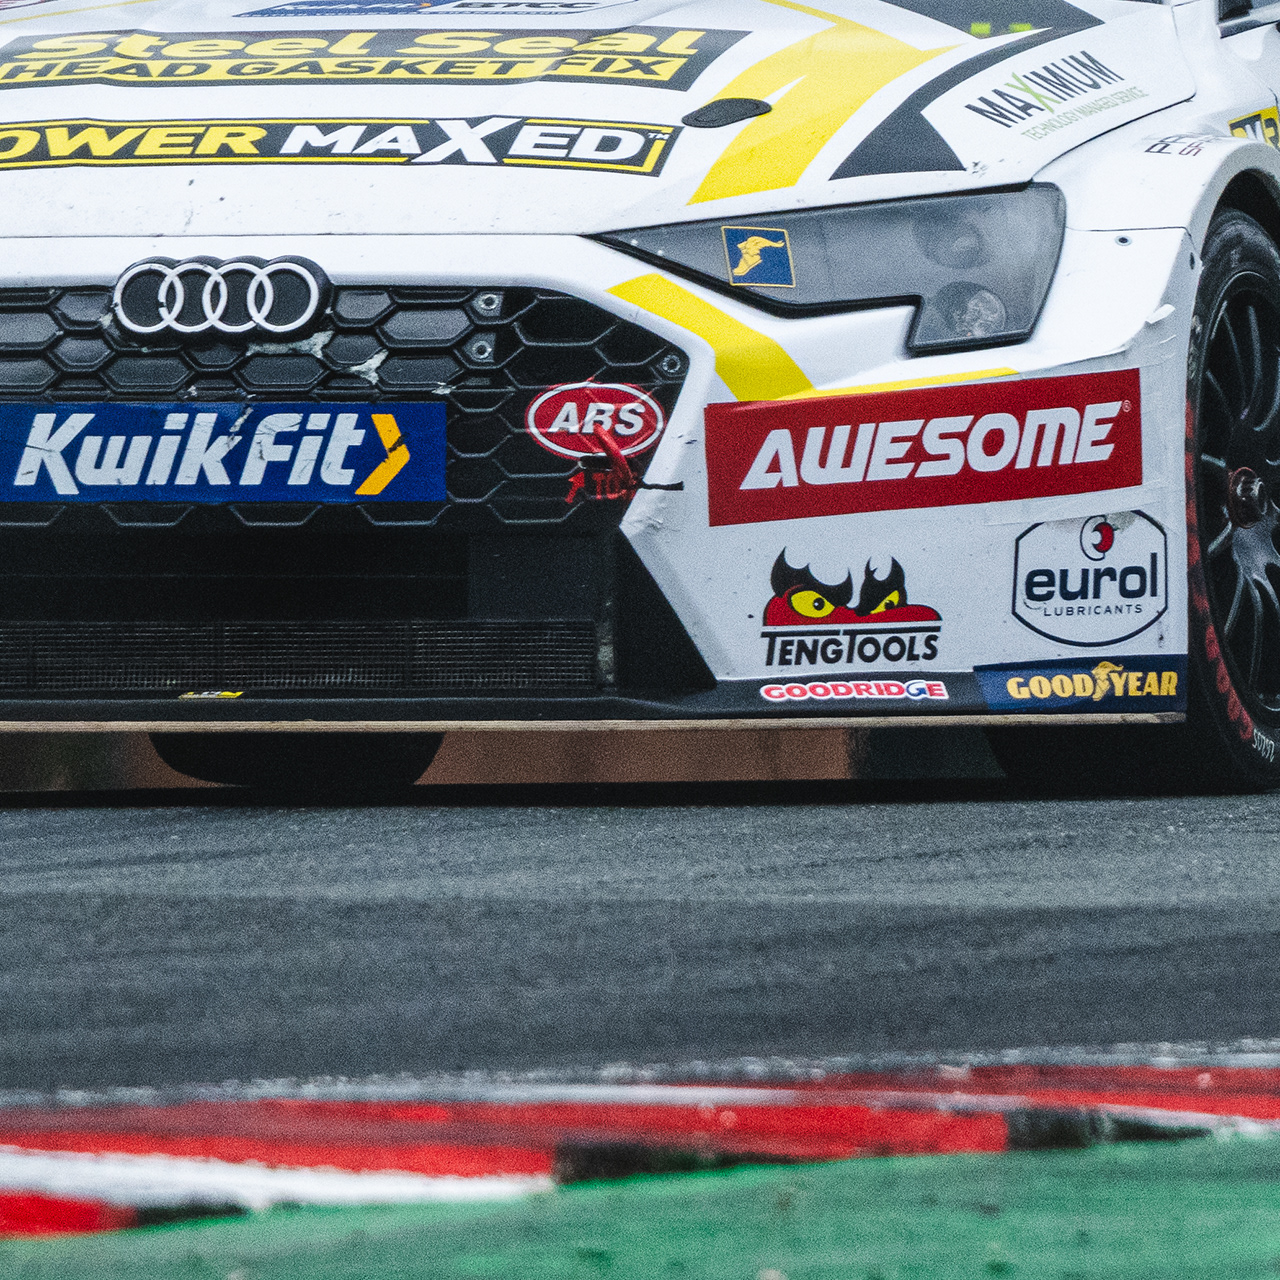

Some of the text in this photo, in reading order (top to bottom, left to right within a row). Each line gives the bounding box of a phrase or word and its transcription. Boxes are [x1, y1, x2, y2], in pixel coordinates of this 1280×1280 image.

[14, 30, 707, 60] Steel Seal
[0, 54, 670, 81] HEAD GASKET FIX
[965, 50, 1126, 129] MAXIMUM
[279, 115, 648, 165] MAXED
[739, 400, 1124, 490] AWESOME
[1024, 552, 1158, 603] eurol
[1043, 604, 1143, 617] LUBRICANTS
[760, 679, 949, 703] GOODRIDGE
